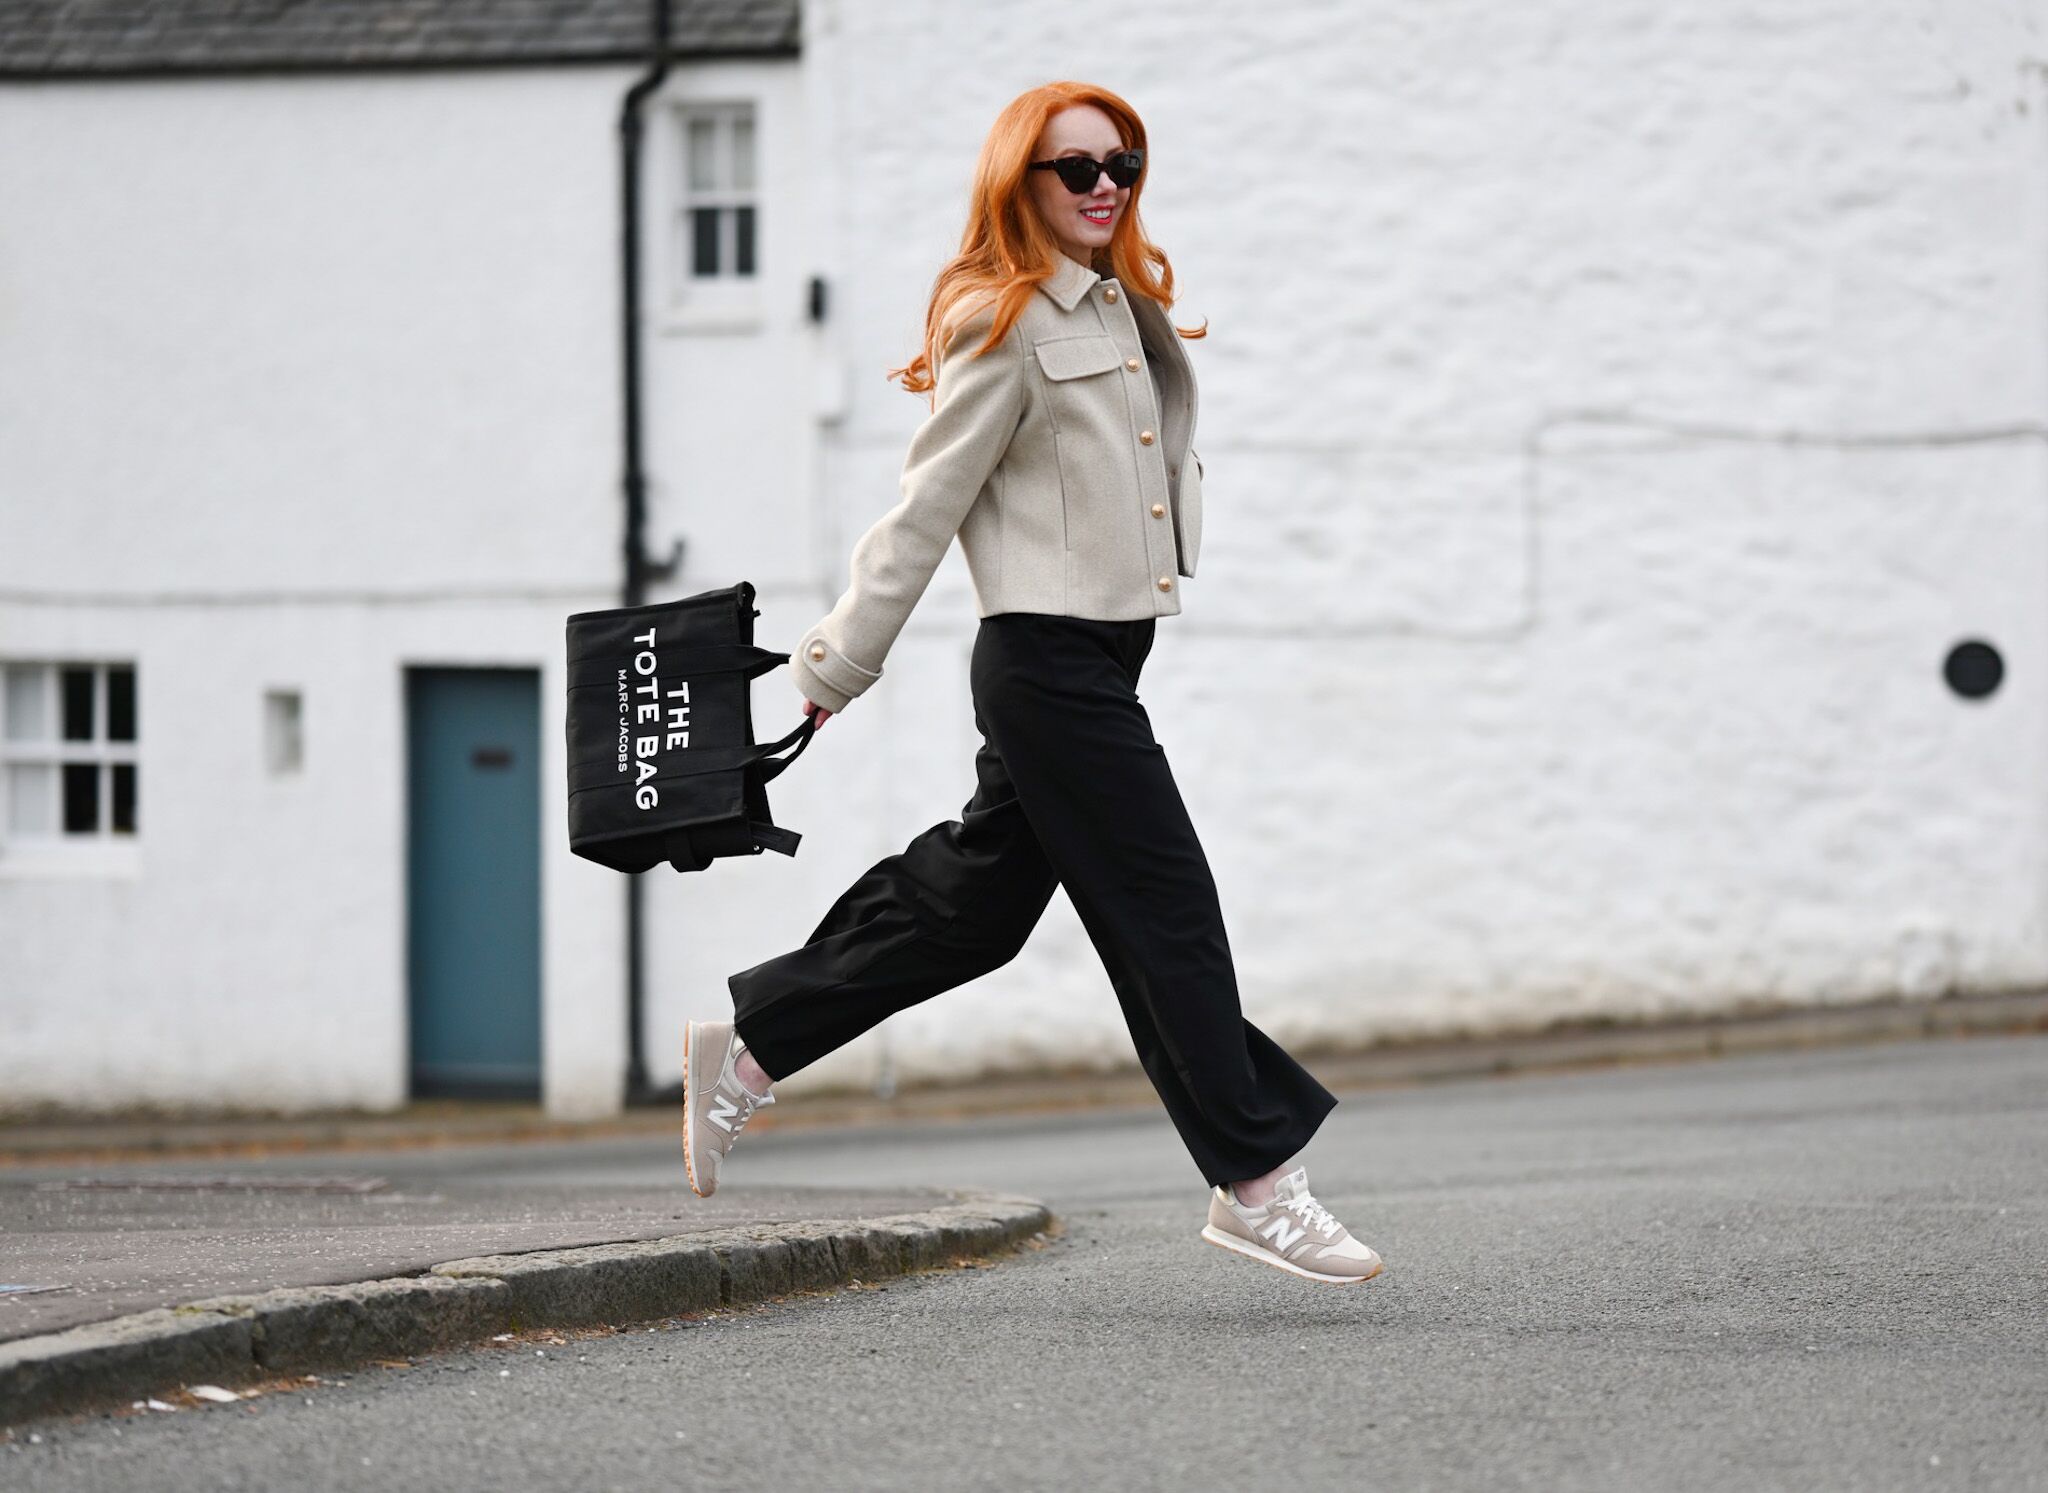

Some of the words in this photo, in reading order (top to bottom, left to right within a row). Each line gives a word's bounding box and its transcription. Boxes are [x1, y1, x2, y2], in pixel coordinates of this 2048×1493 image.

[617, 669, 630, 713] MARC
[634, 627, 660, 724] TOTE
[666, 682, 690, 750] THE
[617, 717, 630, 773] JACOBS
[635, 735, 659, 811] BAG
[707, 1094, 739, 1133] N
[1261, 1216, 1306, 1252] N
